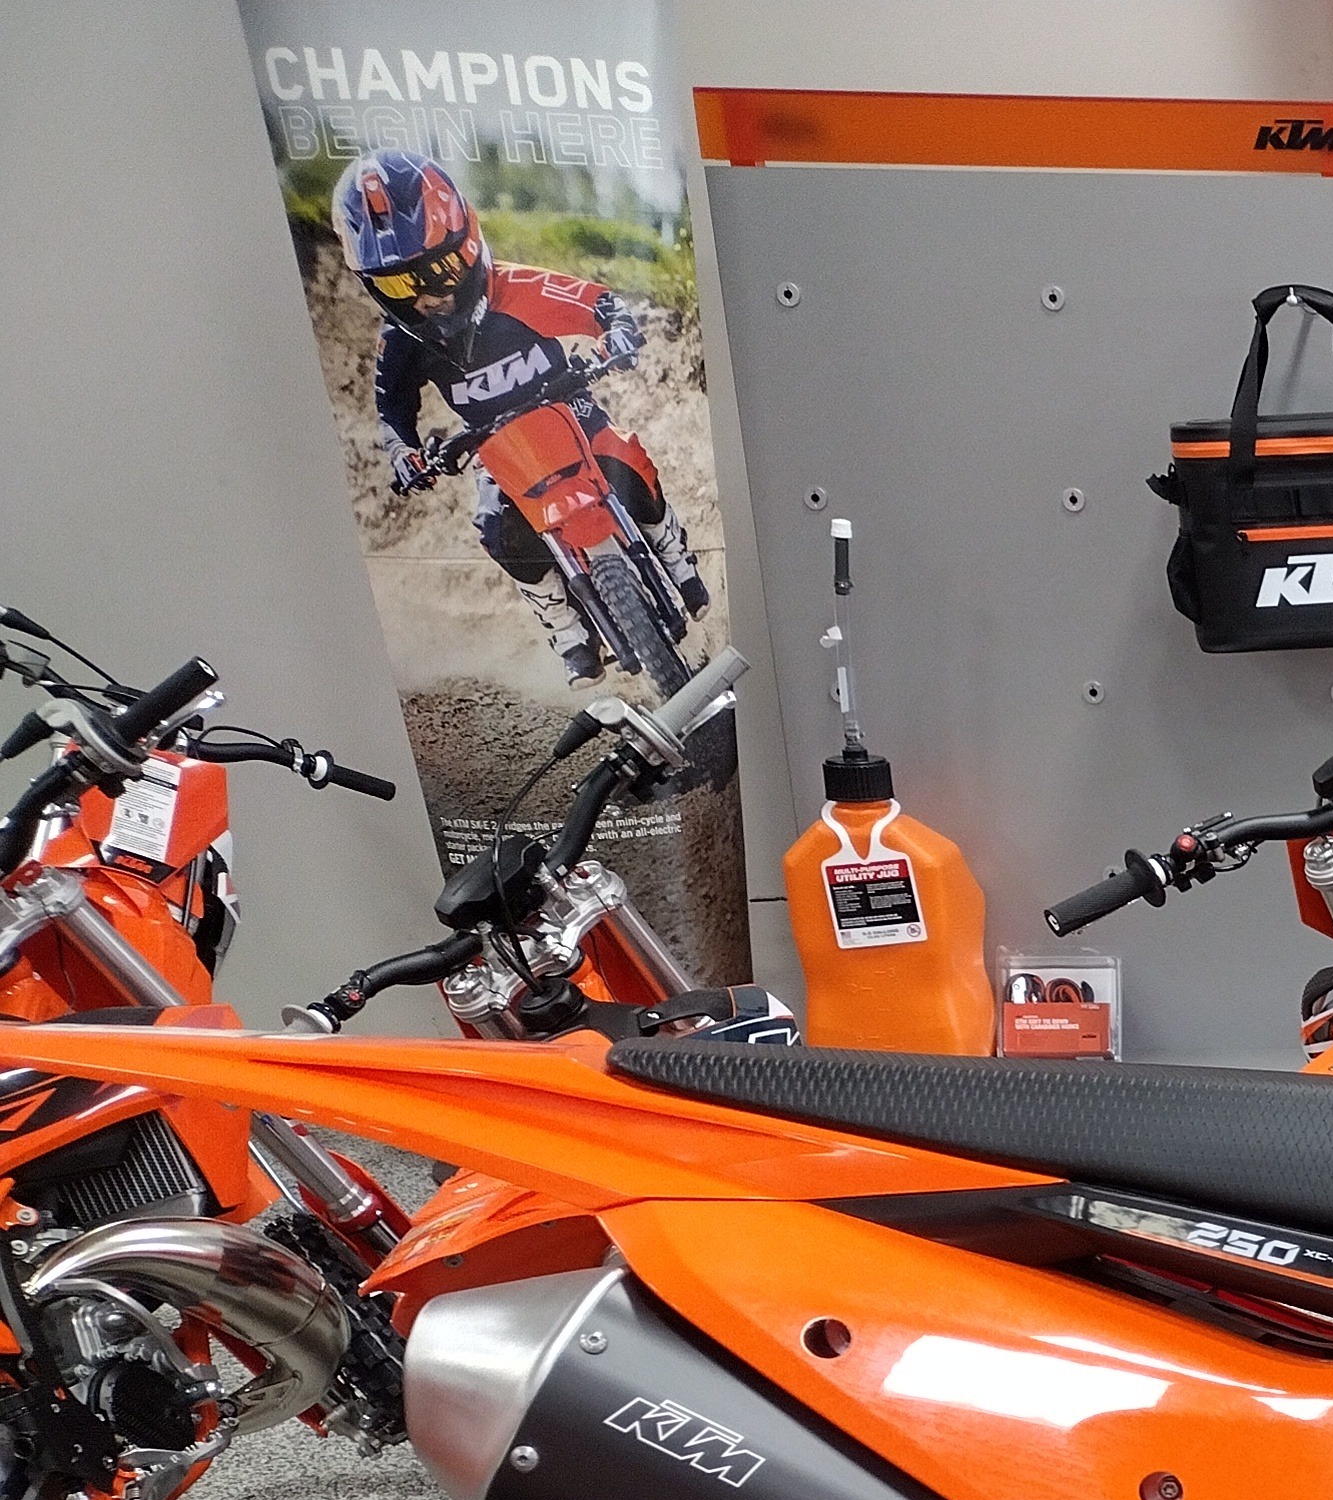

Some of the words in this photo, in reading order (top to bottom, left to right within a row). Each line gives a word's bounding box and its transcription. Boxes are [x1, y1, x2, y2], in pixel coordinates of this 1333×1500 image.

[265, 46, 653, 113] CHAMPIONS
[279, 105, 482, 162] BEGIN
[501, 110, 664, 169] HERE
[451, 343, 551, 404] KTM
[503, 821, 532, 834] ridges
[533, 820, 550, 831] the
[616, 814, 664, 828] mini-cycle
[665, 811, 682, 823] and
[597, 829, 619, 841] with
[620, 829, 634, 839] an
[635, 824, 682, 838] all-electric
[449, 852, 466, 865] GET
[1186, 1222, 1300, 1265] 250
[602, 1396, 766, 1488] KTM
